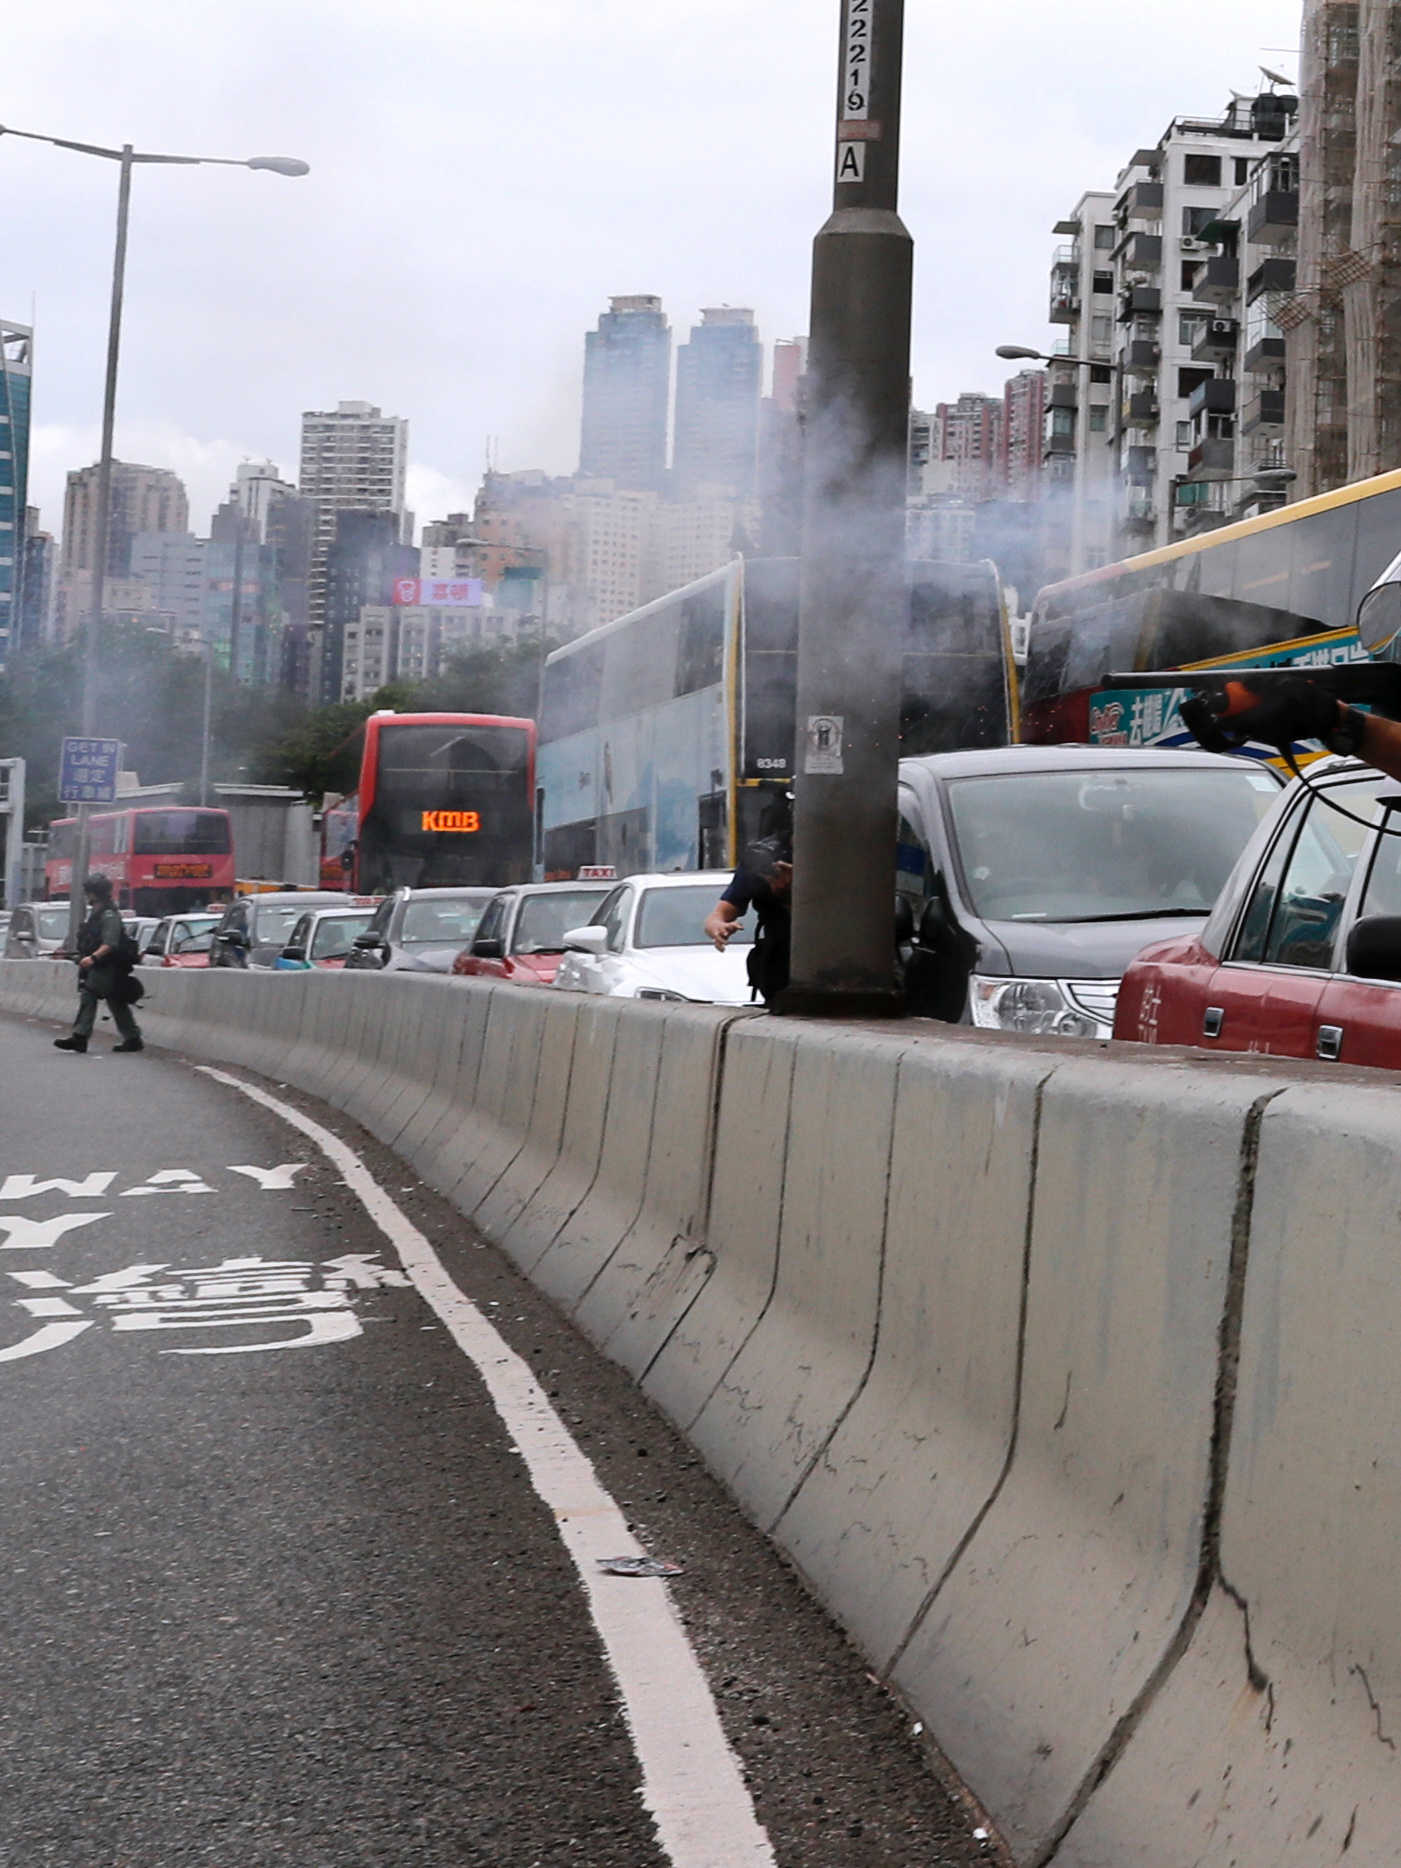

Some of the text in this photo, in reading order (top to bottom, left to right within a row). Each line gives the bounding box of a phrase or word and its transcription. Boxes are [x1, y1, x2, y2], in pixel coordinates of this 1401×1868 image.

[839, 145, 859, 178] A
[67, 742, 99, 753] GET
[70, 755, 109, 767] LANE
[422, 810, 481, 832] KMB
[584, 868, 614, 878] TAXI
